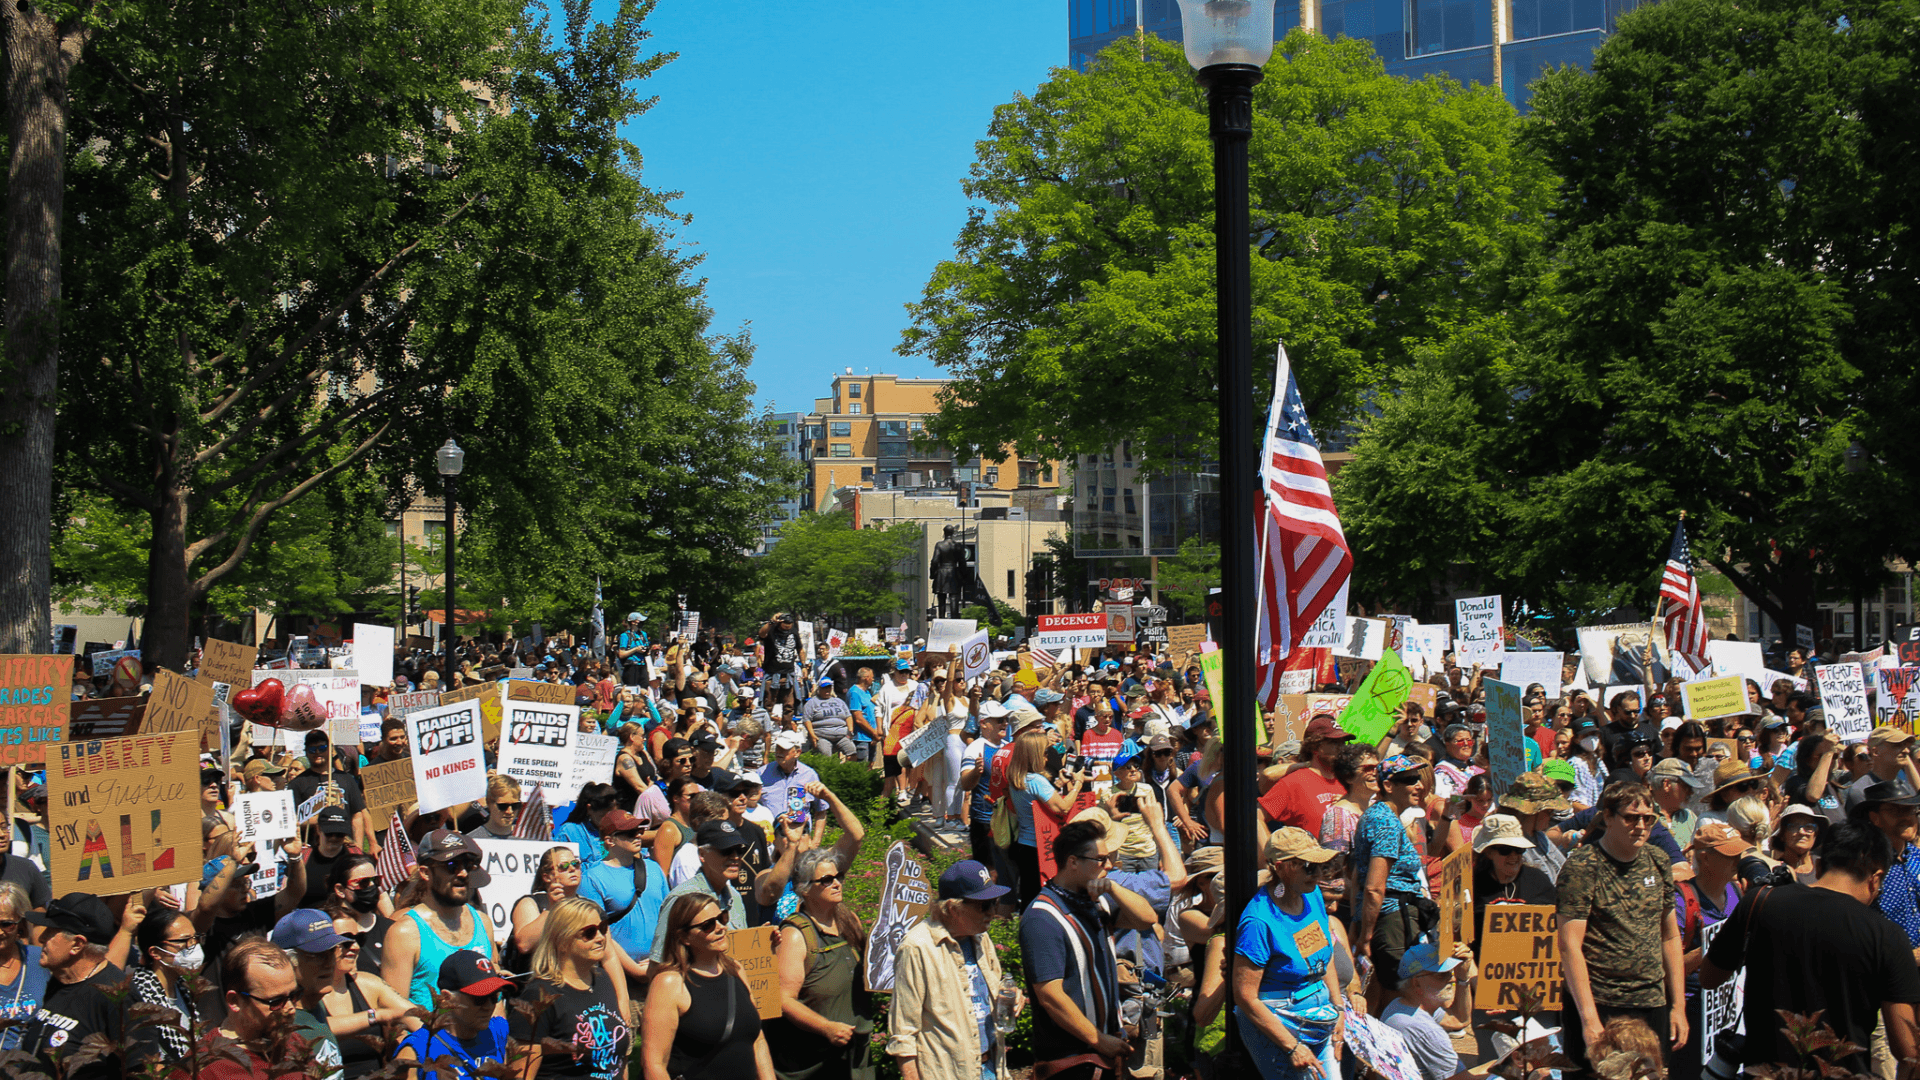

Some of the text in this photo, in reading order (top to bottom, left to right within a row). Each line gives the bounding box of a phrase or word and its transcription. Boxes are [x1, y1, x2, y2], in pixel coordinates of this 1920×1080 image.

[1099, 578, 1145, 591] PARK
[1459, 598, 1494, 612] Donald
[1045, 616, 1100, 626] DECENCY
[1308, 618, 1335, 632] RICA
[1462, 612, 1493, 621] Trump
[1459, 622, 1469, 632] is
[1040, 636, 1066, 644] RULE
[1085, 634, 1105, 643] LAW
[213, 642, 243, 659] My Dad
[0, 656, 74, 688] ITARY
[1879, 668, 1920, 694] POWER
[163, 676, 188, 709] NO
[535, 684, 572, 698] ONLY
[1823, 680, 1863, 693] FOR THOSE
[393, 692, 438, 708] LIBERTY
[1824, 694, 1863, 709] WITHOUT
[1901, 697, 1917, 709] THE
[302, 702, 315, 720] love
[514, 711, 568, 727] HANDS
[1843, 704, 1866, 718] YOUR
[418, 711, 472, 734] HANDS
[1828, 714, 1872, 736] PRIVILEGE
[29, 727, 61, 742] LIKE
[421, 723, 474, 752] OFF!
[513, 723, 567, 745] OFF!
[0, 744, 46, 764] CIS
[61, 735, 176, 778] LIBERTY
[921, 737, 948, 759] GREAT
[425, 758, 476, 780] NO KINGS
[513, 758, 558, 768] FREE SPEECH
[507, 768, 563, 778] FREE ASSEMBLY
[524, 780, 561, 789] HUMANITY
[64, 785, 90, 806] and
[243, 800, 257, 840] LIMOUSIN
[298, 802, 311, 823] NO
[55, 809, 175, 881] for ALL
[1042, 824, 1055, 861] MAKE
[895, 884, 930, 904] KINGS
[482, 902, 506, 928] O
[751, 929, 761, 948] A
[1532, 936, 1553, 959] M
[750, 979, 769, 990] HIM
